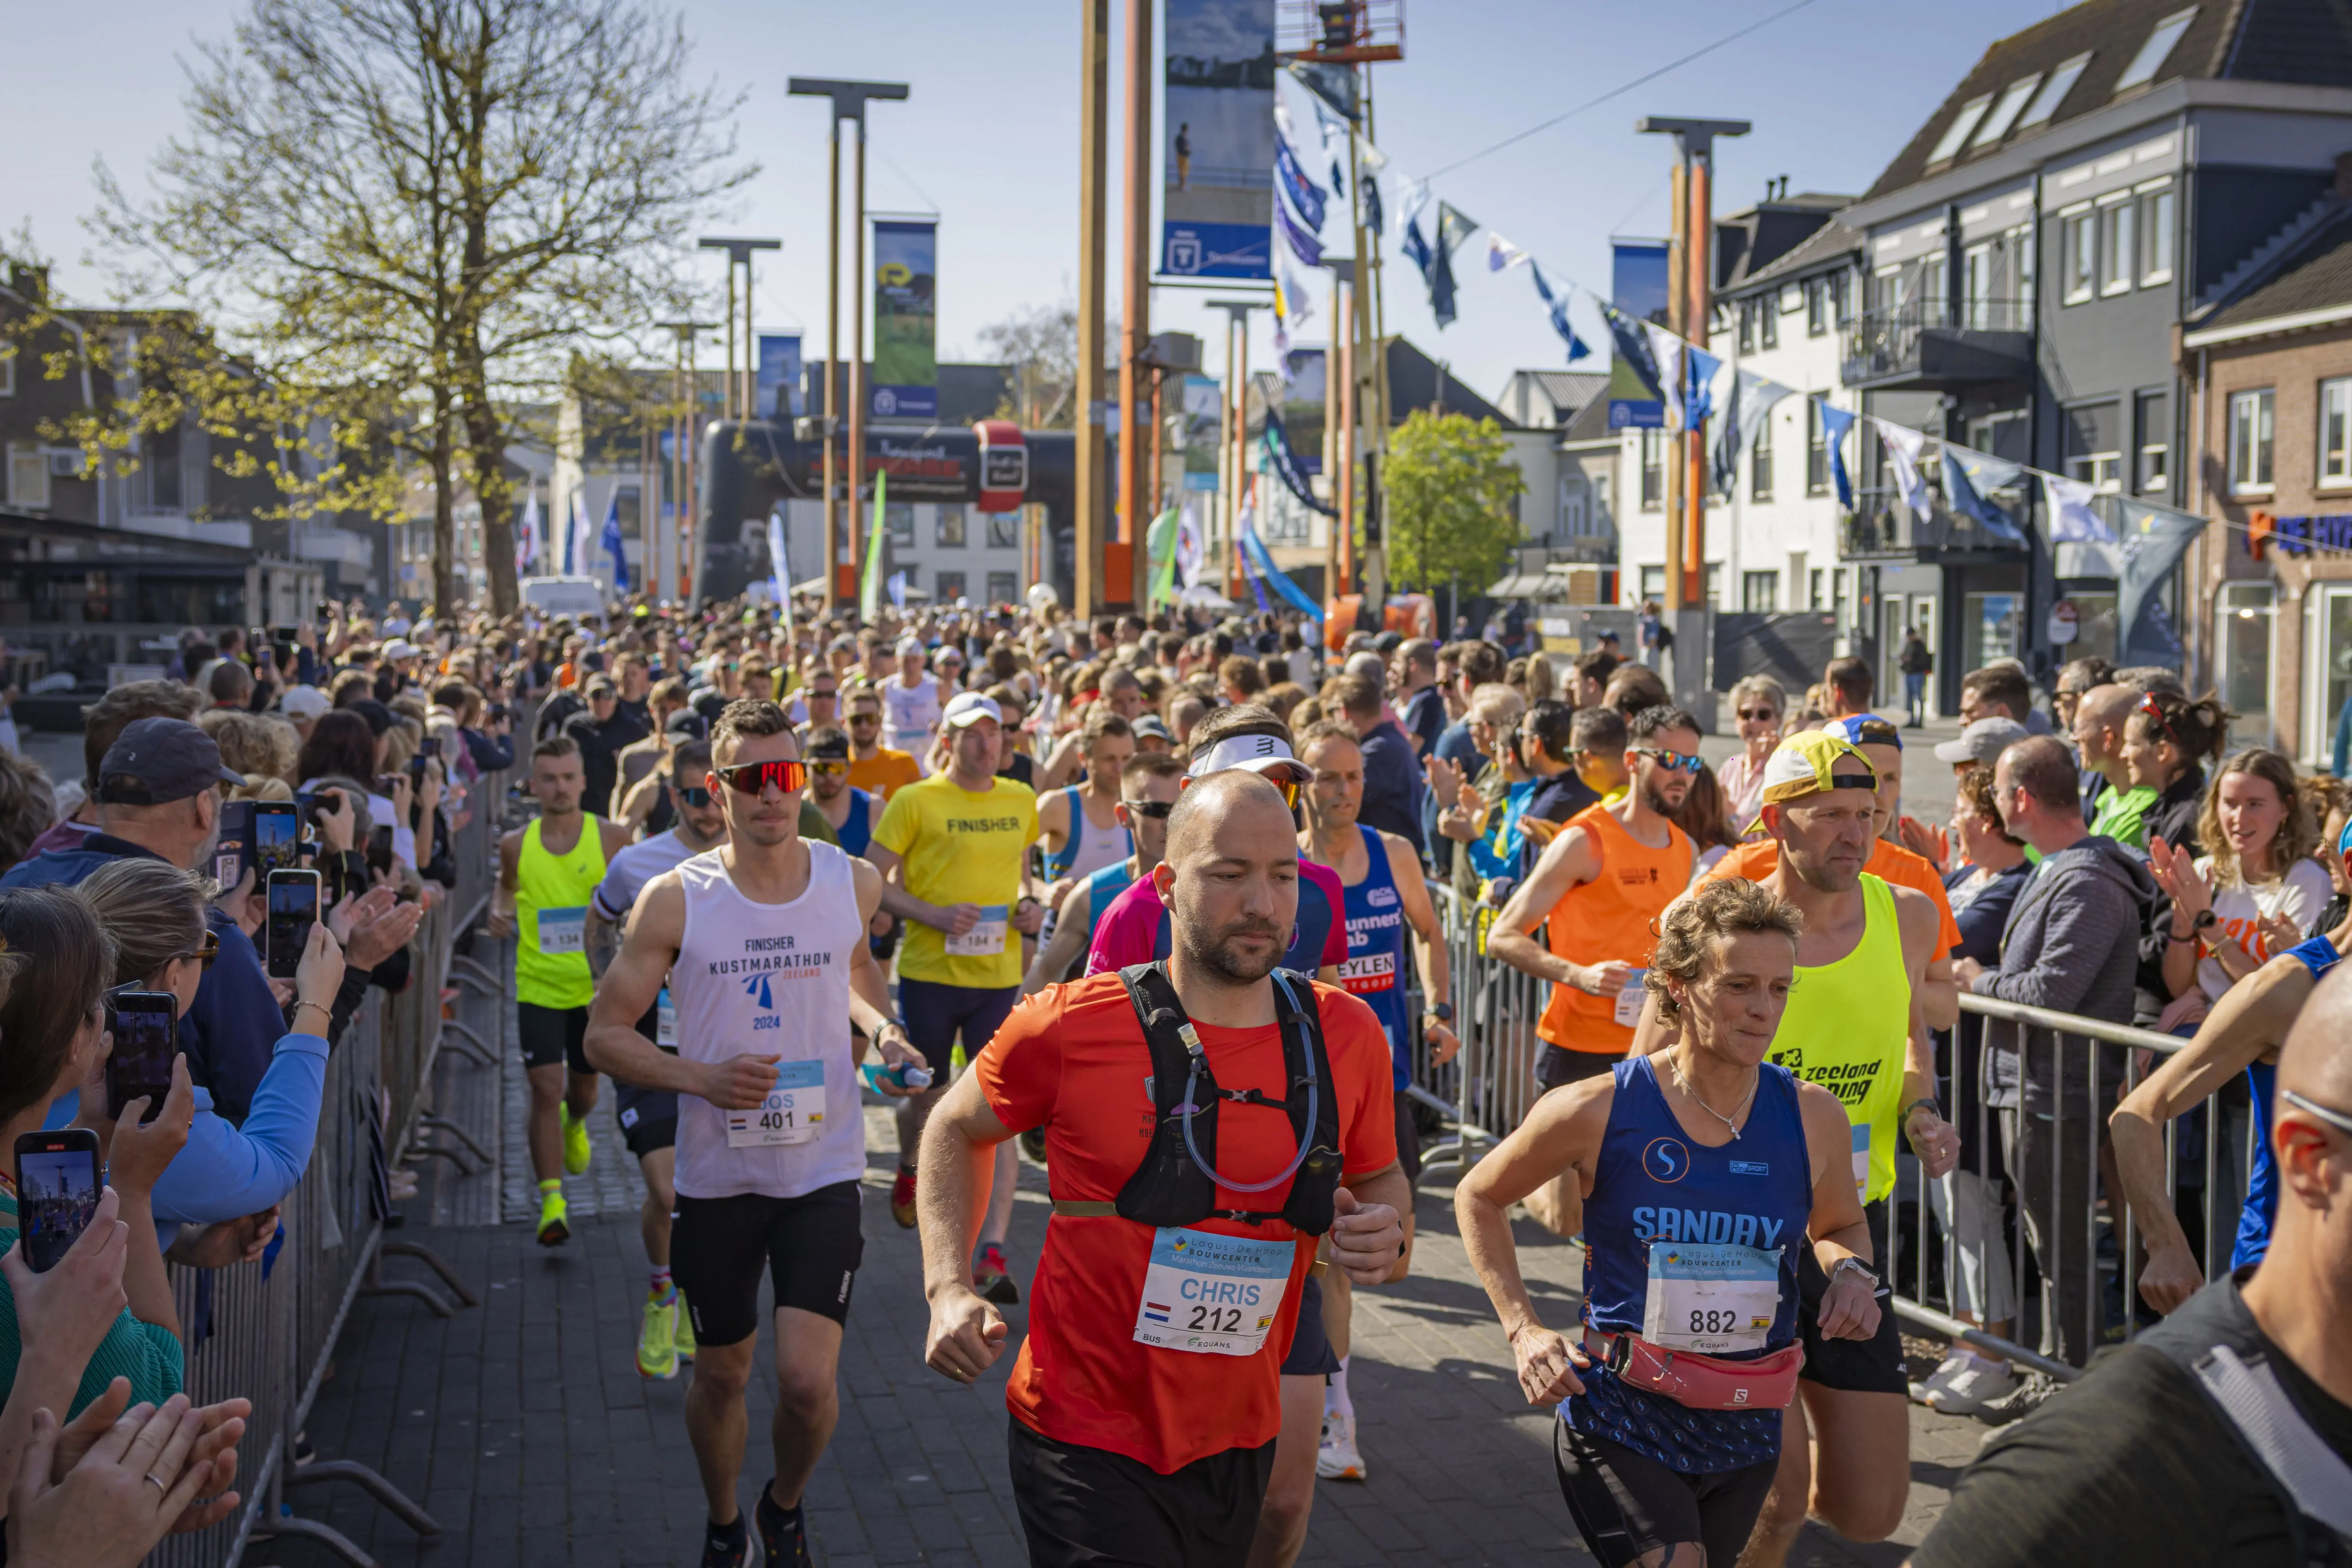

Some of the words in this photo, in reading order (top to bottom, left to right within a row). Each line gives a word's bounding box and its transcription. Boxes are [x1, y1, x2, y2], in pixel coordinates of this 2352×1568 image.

[947, 816, 1021, 833] FINISHER
[745, 936, 794, 952] FINISHER
[709, 952, 831, 974] KUSTMARATHON
[783, 968, 821, 980] ZEELAND
[753, 1015, 781, 1030] 2024
[1805, 1059, 1883, 1081] zeeland
[760, 1111, 793, 1129] 401
[1633, 1207, 1784, 1249] SANDAY
[1189, 1249, 1260, 1263] BOUWCENTER
[1256, 1247, 1282, 1256] Hoop
[1171, 1254, 1207, 1267] Marathon
[1209, 1262, 1272, 1273] Zeeuws-Vlaanderen
[838, 1270, 851, 1303] FUSION
[1180, 1278, 1261, 1306] CHRIS
[1188, 1305, 1242, 1332] 212
[1690, 1310, 1736, 1333] 882
[1143, 1334, 1161, 1343] BUS
